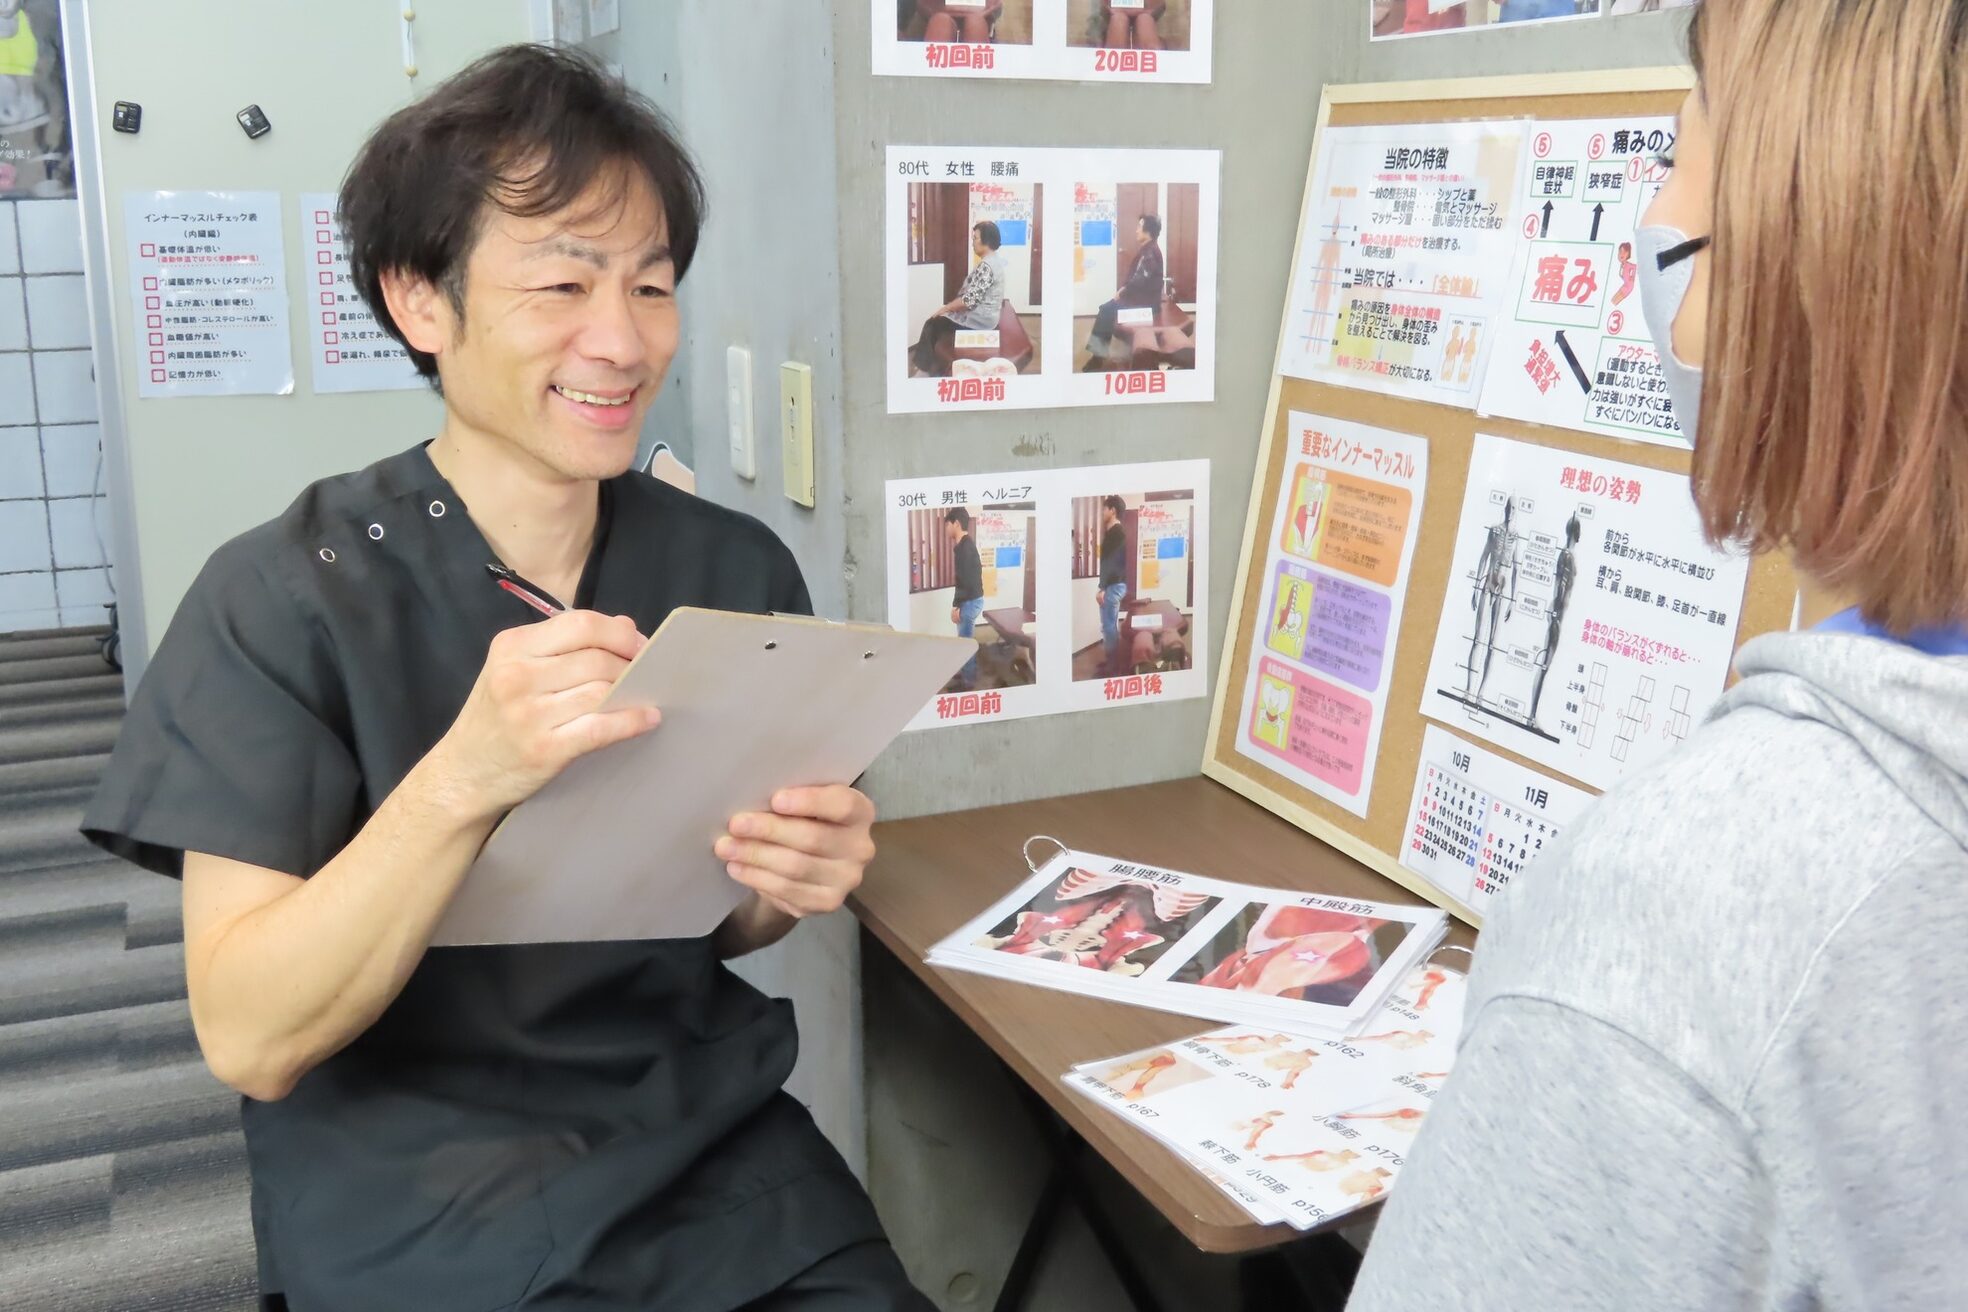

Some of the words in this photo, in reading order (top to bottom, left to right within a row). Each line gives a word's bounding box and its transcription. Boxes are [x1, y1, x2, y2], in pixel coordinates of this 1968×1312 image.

[926, 44, 994, 69] 初回前
[1095, 50, 1158, 72] 20回目
[899, 161, 929, 176] 80代
[946, 160, 975, 176] 女性
[991, 161, 1019, 176] 腰痛
[1384, 147, 1449, 170] 当院の特徴
[1536, 166, 1575, 180] 自律神経
[1588, 173, 1623, 189] 狭窄症
[1543, 181, 1563, 194] 症状
[145, 213, 258, 222] インナーマッスルチェック表
[1532, 254, 1598, 304] 痛み
[167, 333, 219, 341] 血糖値が高い
[937, 378, 1005, 402] 初回前
[1104, 372, 1166, 395] 10回目
[1301, 430, 1414, 479] 重要なインナーマッスル
[898, 493, 926, 507] 30代
[941, 490, 967, 504] 男性
[982, 485, 1032, 500] ヘルニア
[1559, 466, 1642, 505] 理想の姿勢
[1605, 529, 1629, 545] 前から
[1603, 541, 1715, 581] 各関節が水平に水平に横並び
[1599, 565, 1622, 581] 横から
[1104, 675, 1163, 700] 初回後
[1567, 680, 1585, 694] 上半身
[936, 692, 1002, 719] 初回前
[1560, 720, 1577, 735] 下半身
[1451, 750, 1471, 773] 10月
[1427, 782, 1431, 792] 1
[1435, 787, 1440, 797] 2
[1443, 791, 1448, 801] 3
[1450, 796, 1455, 806] 4
[1459, 800, 1464, 811] 5
[1467, 805, 1473, 816] 6
[1477, 810, 1484, 820] 7
[1525, 786, 1549, 809] 11月
[1423, 796, 1428, 807] 8
[1432, 801, 1437, 812] 9
[1439, 805, 1446, 817] 10
[1447, 810, 1454, 821] 11
[1454, 814, 1462, 827] 12
[1463, 819, 1472, 832] 13
[1473, 824, 1482, 837] 14
[1419, 810, 1427, 822] 15
[1428, 815, 1435, 827] 16
[1436, 819, 1443, 831] 17
[1443, 824, 1451, 837] 18
[1452, 829, 1459, 842] 19
[1459, 834, 1469, 847] 20
[1469, 839, 1478, 852] 21
[1524, 834, 1529, 844] 1
[1535, 839, 1542, 849] 2
[1412, 838, 1422, 851] 29
[1422, 843, 1430, 855] 30
[1430, 848, 1437, 861] 31
[1415, 824, 1425, 836] 22
[1424, 829, 1433, 842] 23
[1432, 834, 1440, 846] 24
[1440, 839, 1448, 851] 25
[1448, 844, 1456, 857] 26
[1456, 849, 1465, 861] 27
[1465, 854, 1475, 867] 28
[1487, 833, 1493, 843] 5
[1498, 838, 1504, 848] 6
[1509, 843, 1515, 853] 7
[1520, 849, 1526, 859] 8
[1482, 847, 1492, 860] 12
[1493, 852, 1502, 865] 13
[1503, 858, 1513, 871] 14
[1479, 863, 1489, 875] 19
[1488, 868, 1499, 880] 20
[1499, 873, 1509, 885] 21
[1475, 878, 1485, 890] 26
[1485, 883, 1496, 895] 27
[1300, 896, 1376, 915] 中殿筋
[1324, 1040, 1364, 1059] p162
[1235, 1071, 1271, 1089] p178
[1126, 1103, 1160, 1118] p167
[1246, 1169, 1290, 1194] 小円筋
